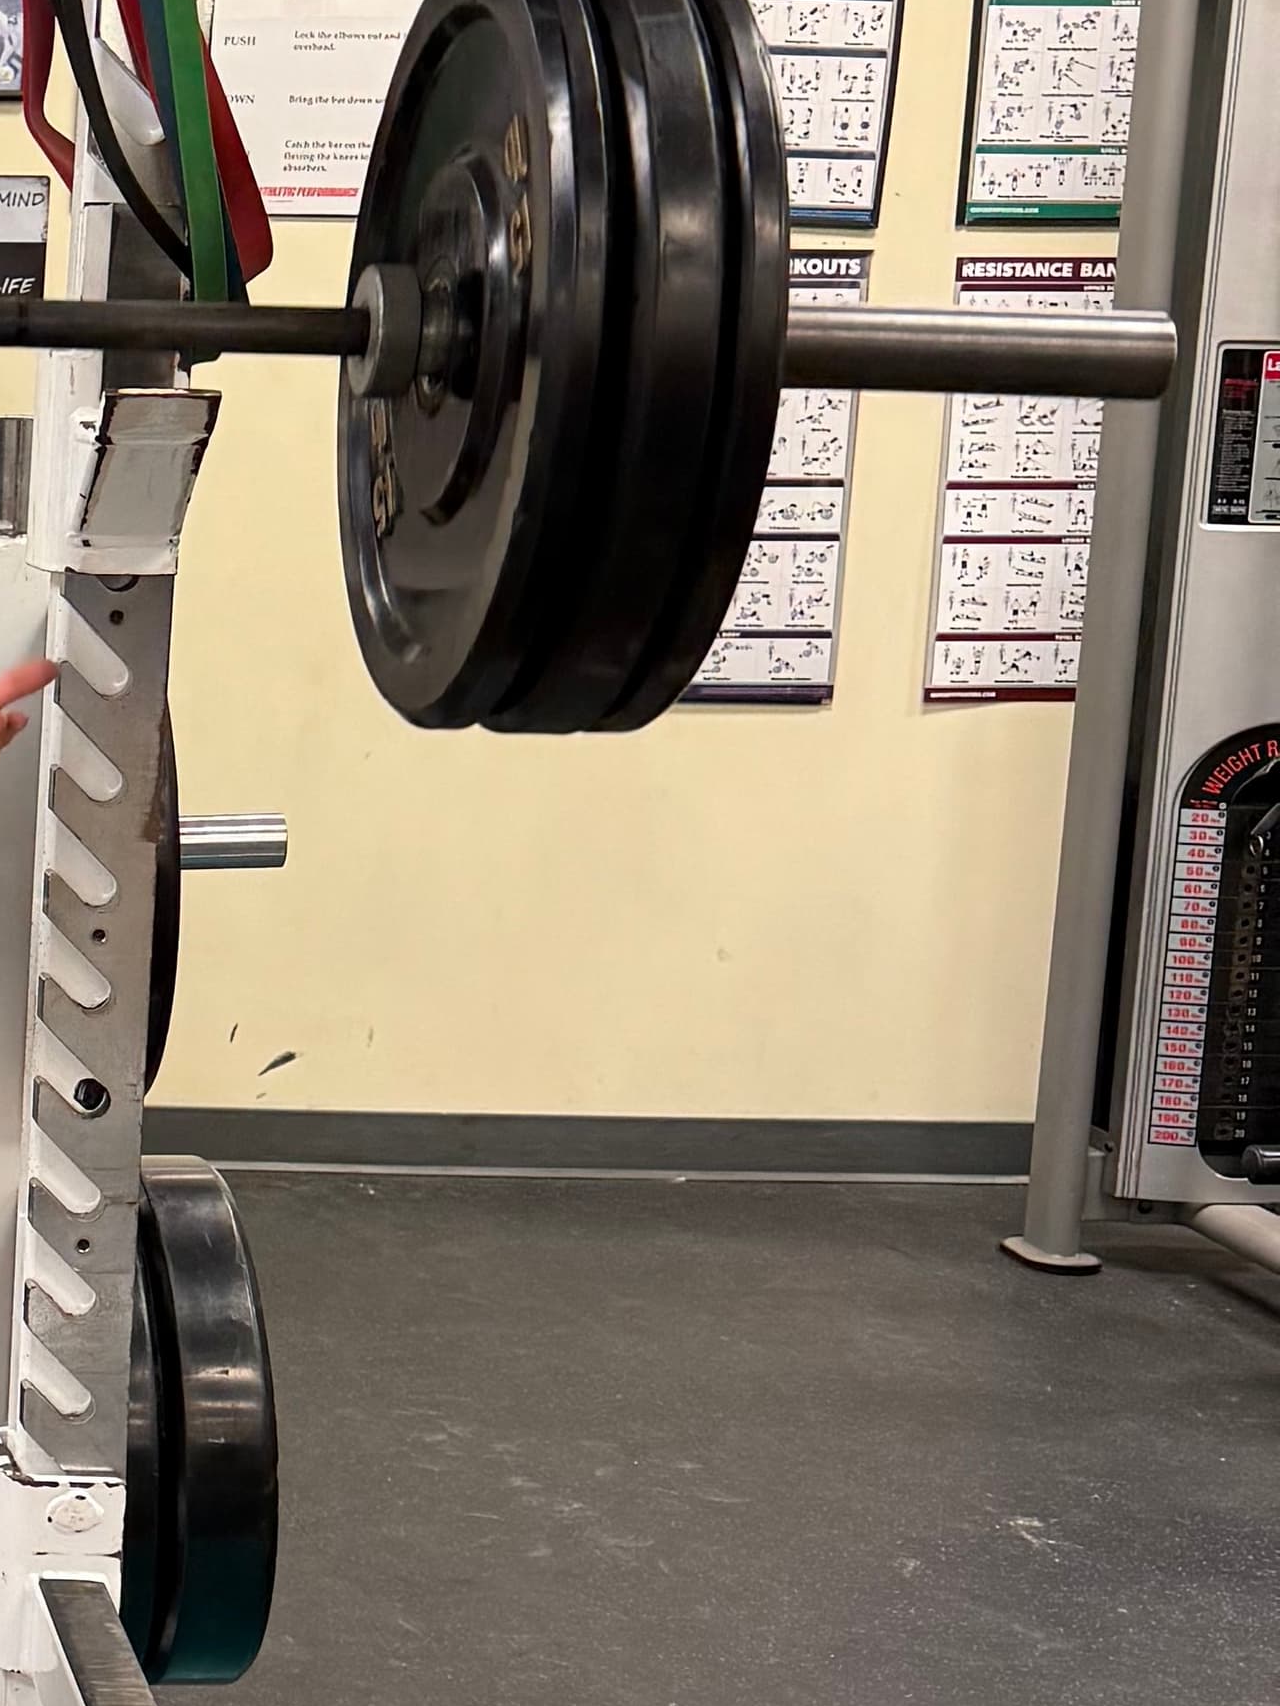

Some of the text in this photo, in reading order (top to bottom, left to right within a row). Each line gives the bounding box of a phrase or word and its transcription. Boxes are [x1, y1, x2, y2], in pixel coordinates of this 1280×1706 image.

[224, 36, 256, 46] PUSH
[790, 258, 861, 275] KOUTS
[961, 262, 1117, 278] RESISTANCE BAN
[1202, 743, 1261, 795] WEIGHT
